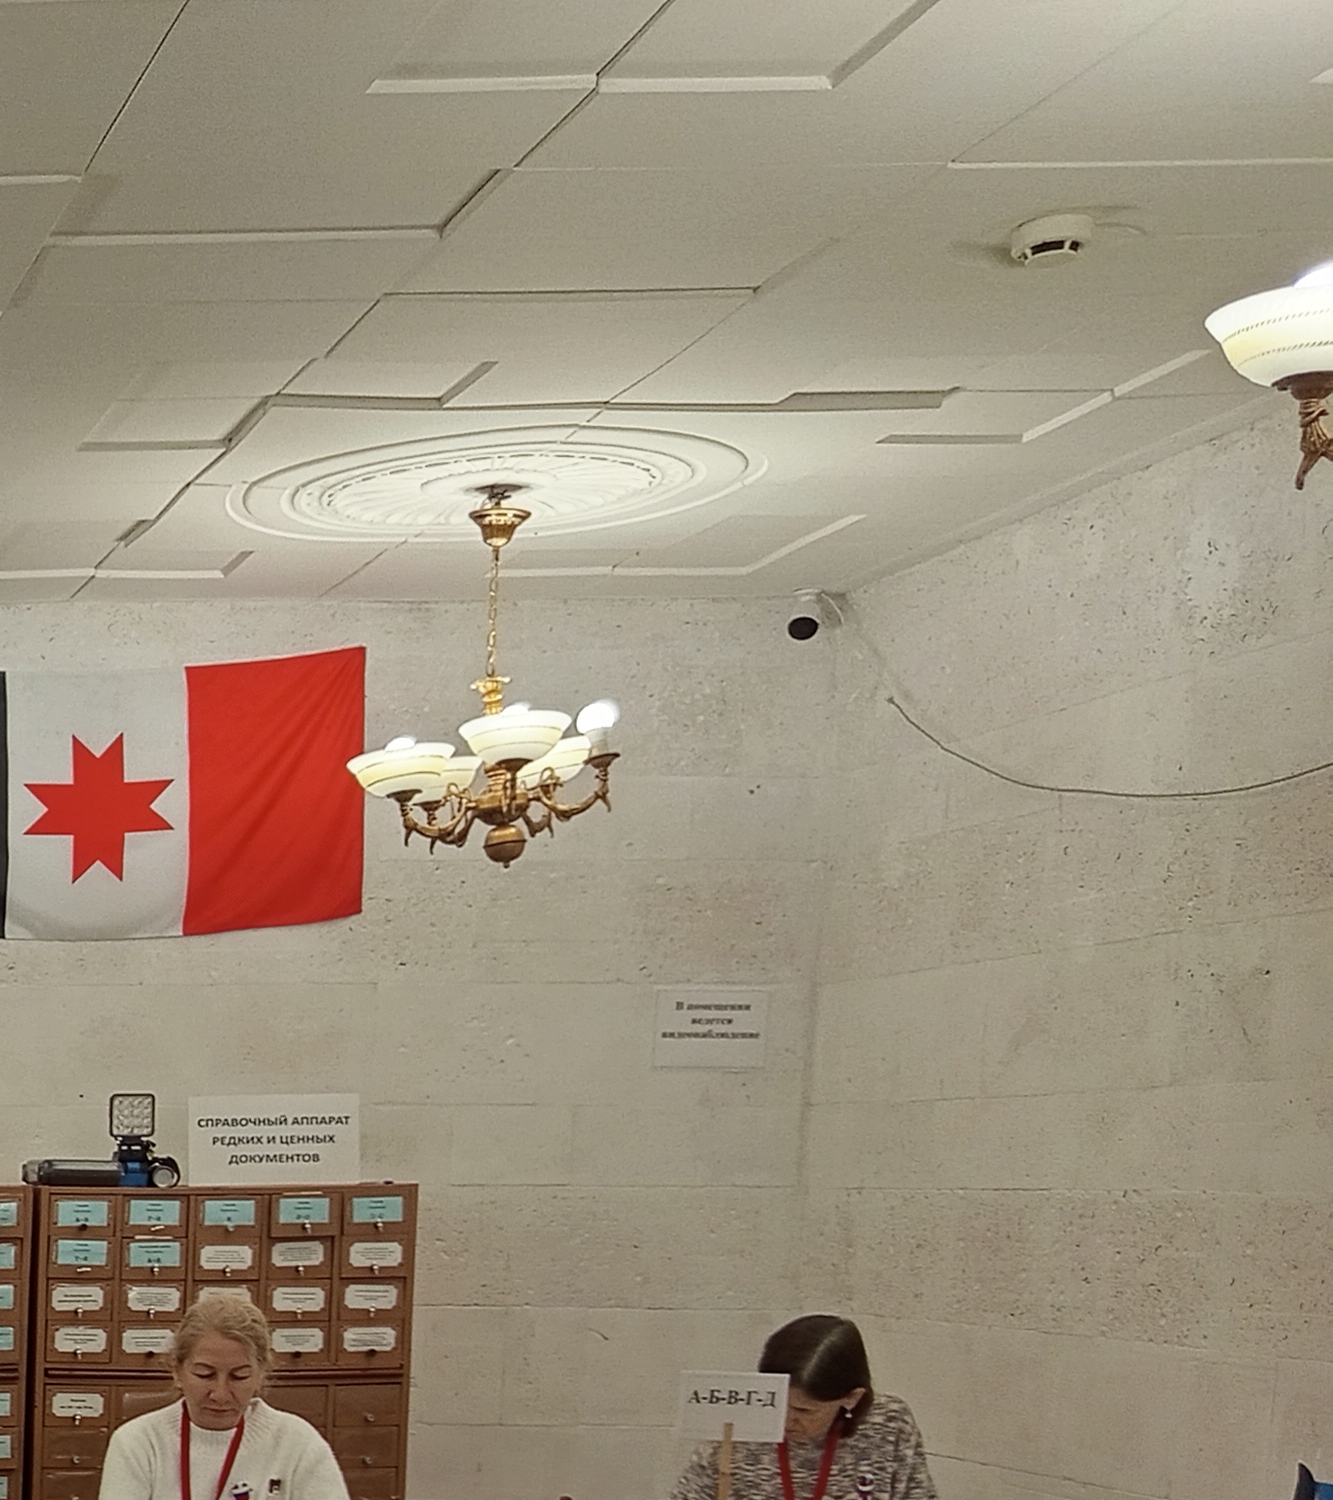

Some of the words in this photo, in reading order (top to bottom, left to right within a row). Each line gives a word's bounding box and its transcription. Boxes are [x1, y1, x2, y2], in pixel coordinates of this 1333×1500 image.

[197, 1115, 288, 1128] СПРАВОЧНЫЙ
[291, 1116, 350, 1126] АППАРАТ
[212, 1136, 264, 1147] РЕДКИХ
[266, 1136, 276, 1145] И
[279, 1135, 335, 1146] ЦЕННЫХ
[228, 1153, 320, 1165] ДОКУМЕНТОВ
[688, 1389, 776, 1408] А-Б-В-Г-Д
